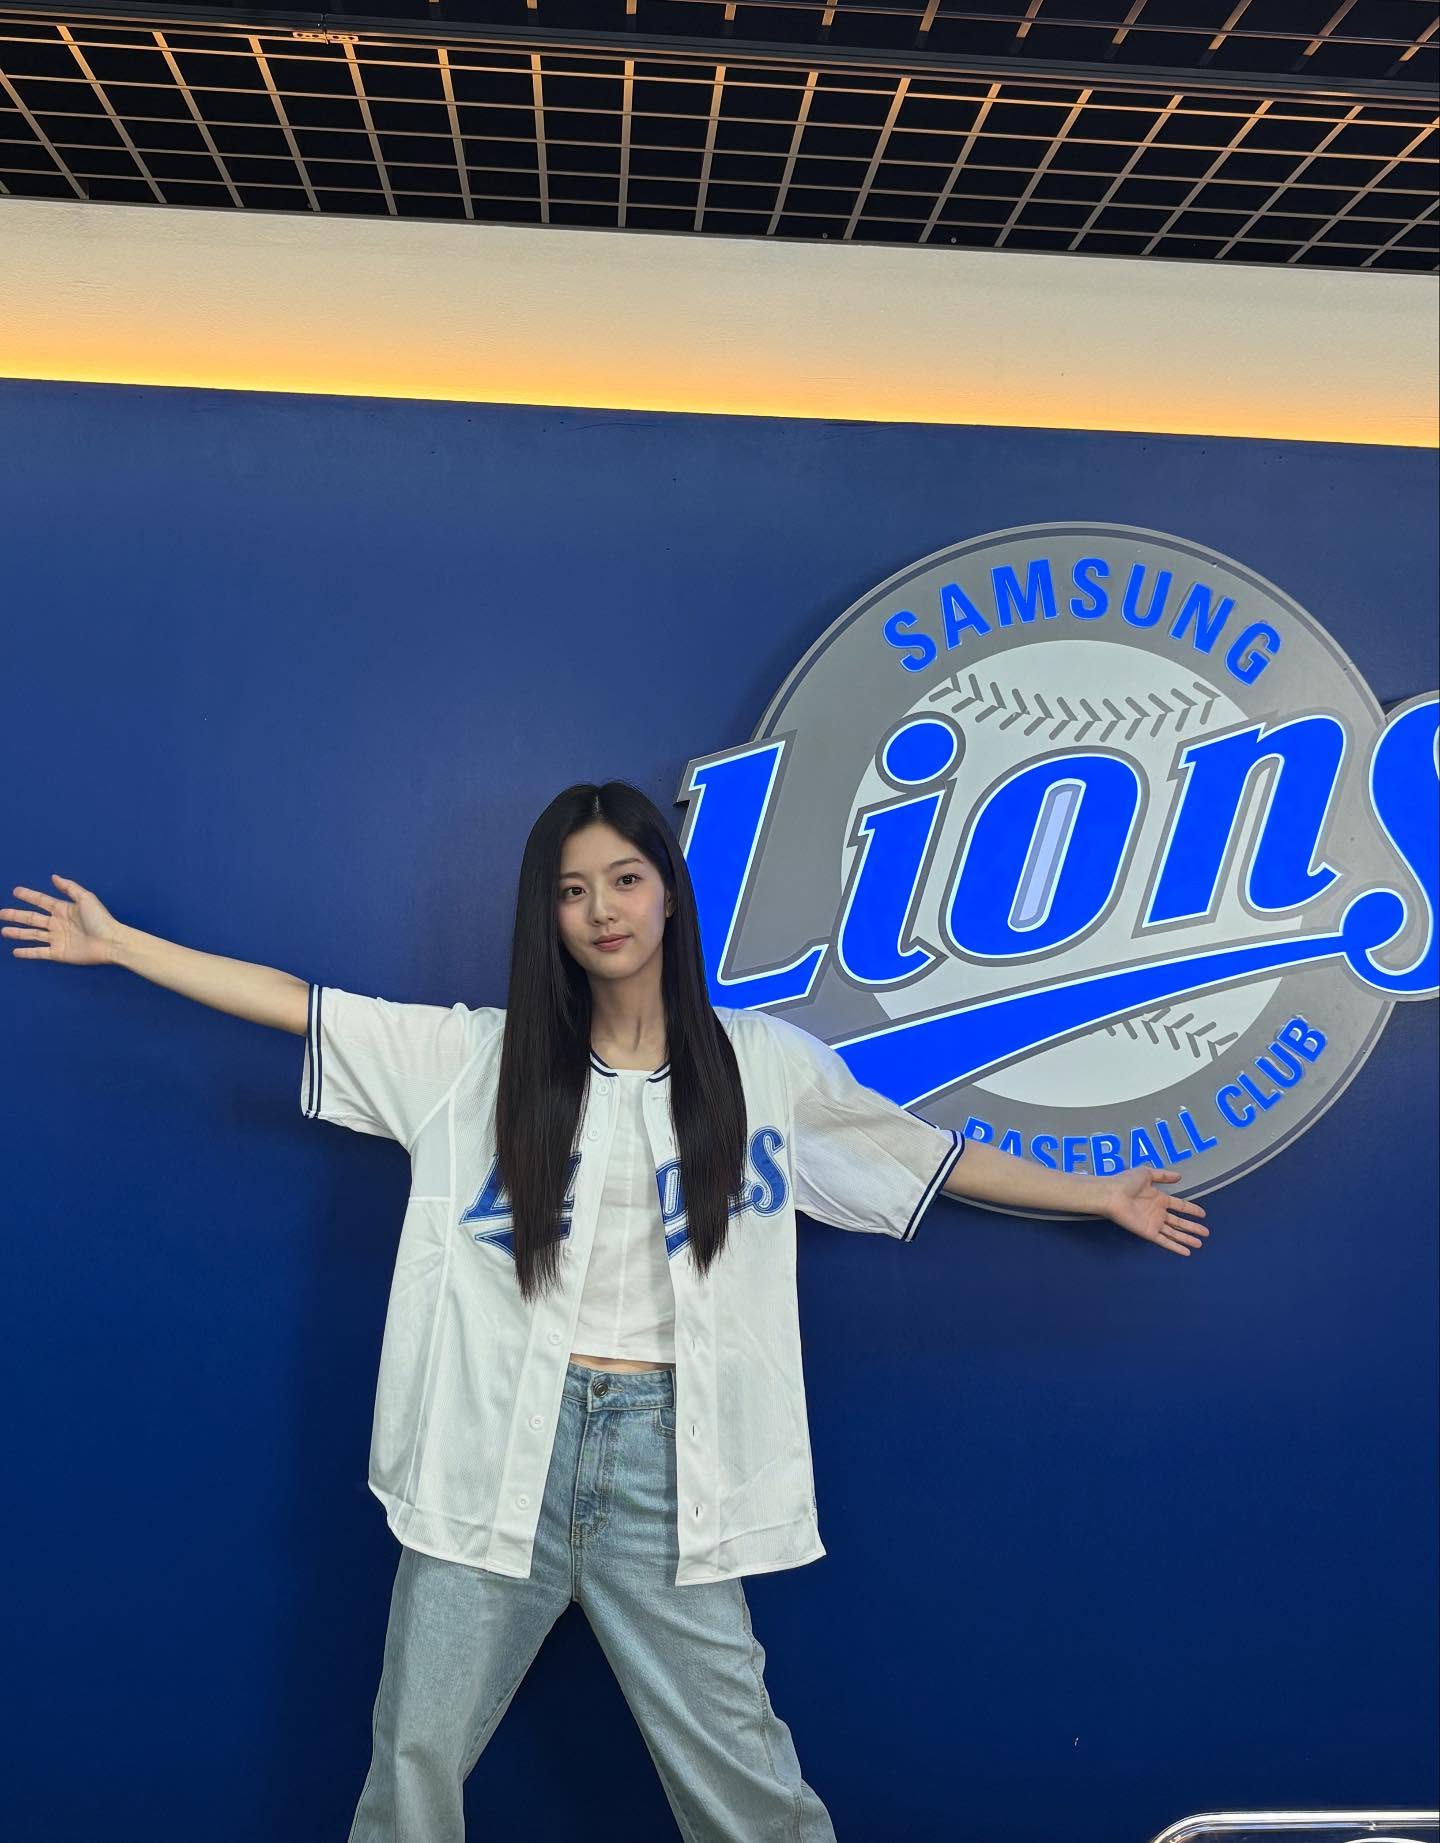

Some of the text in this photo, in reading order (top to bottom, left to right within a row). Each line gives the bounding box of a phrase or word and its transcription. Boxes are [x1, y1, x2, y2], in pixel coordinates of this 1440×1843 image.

[882, 557, 1282, 687] SAMSUNG
[683, 696, 1440, 1014] Lions
[1214, 1016, 1328, 1129] CLUB
